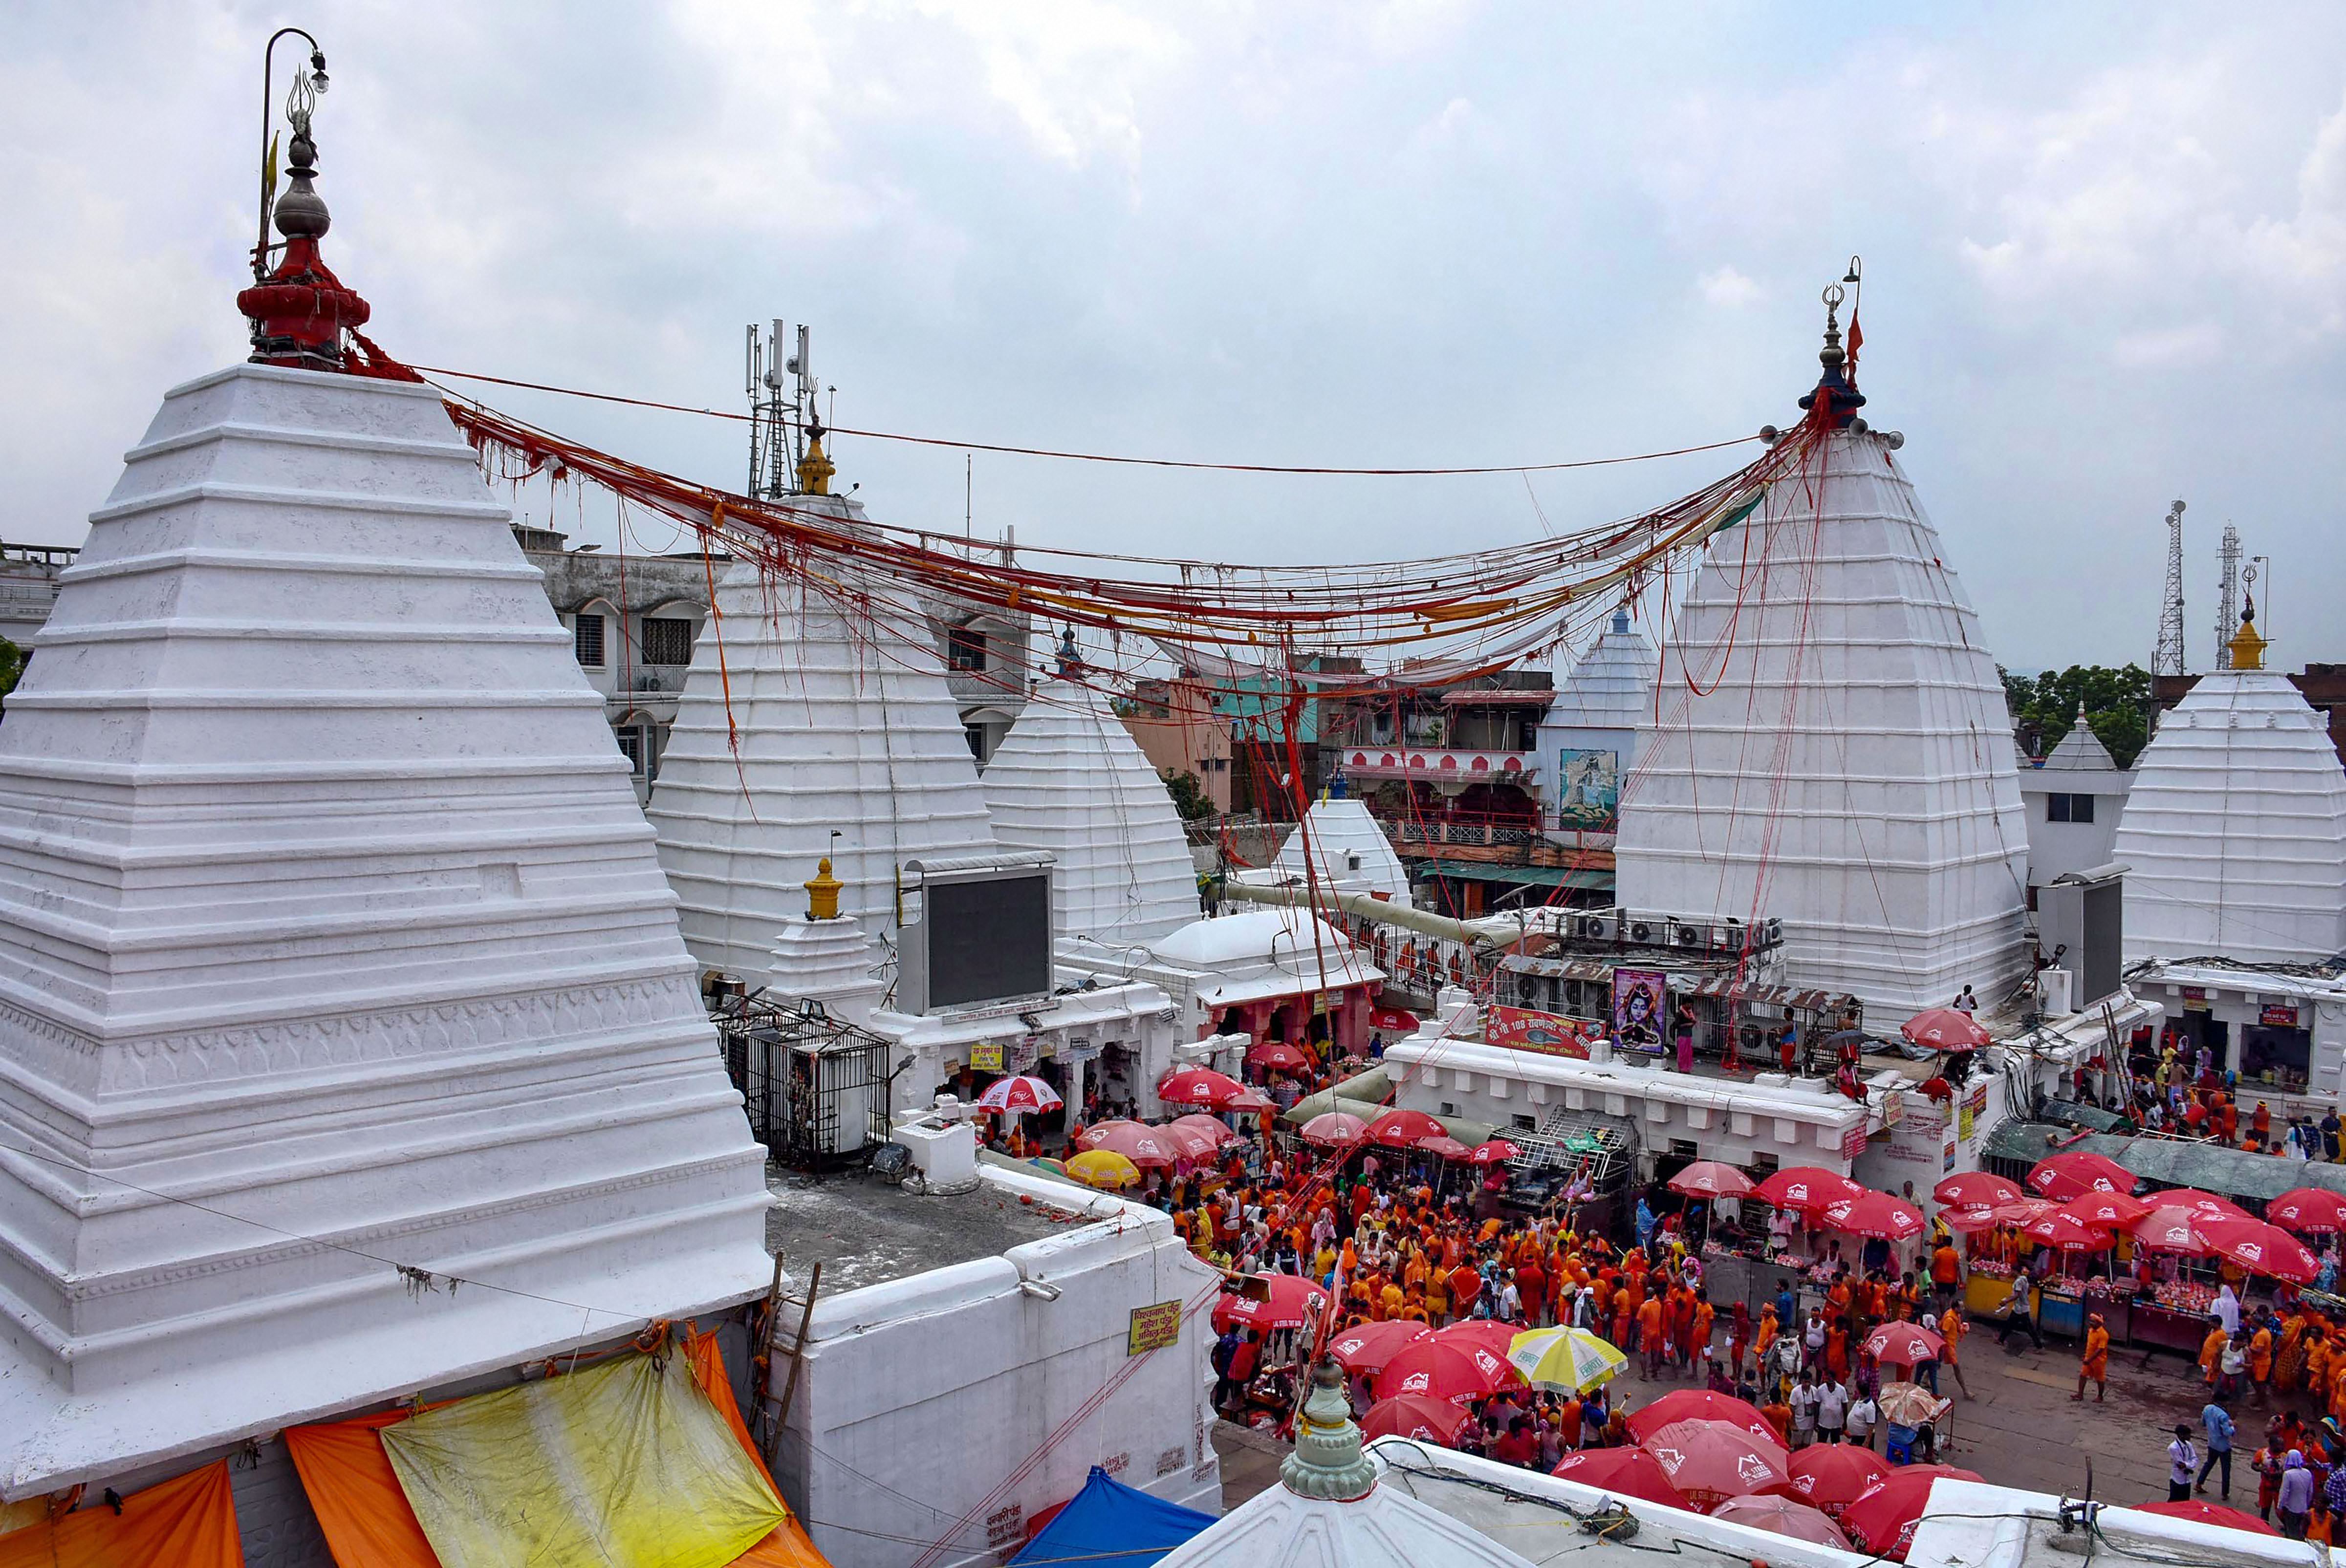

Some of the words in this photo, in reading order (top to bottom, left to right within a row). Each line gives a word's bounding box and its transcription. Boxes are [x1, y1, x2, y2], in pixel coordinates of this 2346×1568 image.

[1511, 1020, 1525, 1031] 108
[1134, 1307, 1167, 1320] विश्वनाथ
[1140, 1318, 1158, 1329] महेश
[1136, 1329, 1159, 1341] अनिल
[1738, 1470, 1752, 1479] LAL
[1751, 1464, 1768, 1476] STEEL
[1833, 1503, 1845, 1512] STEEL
